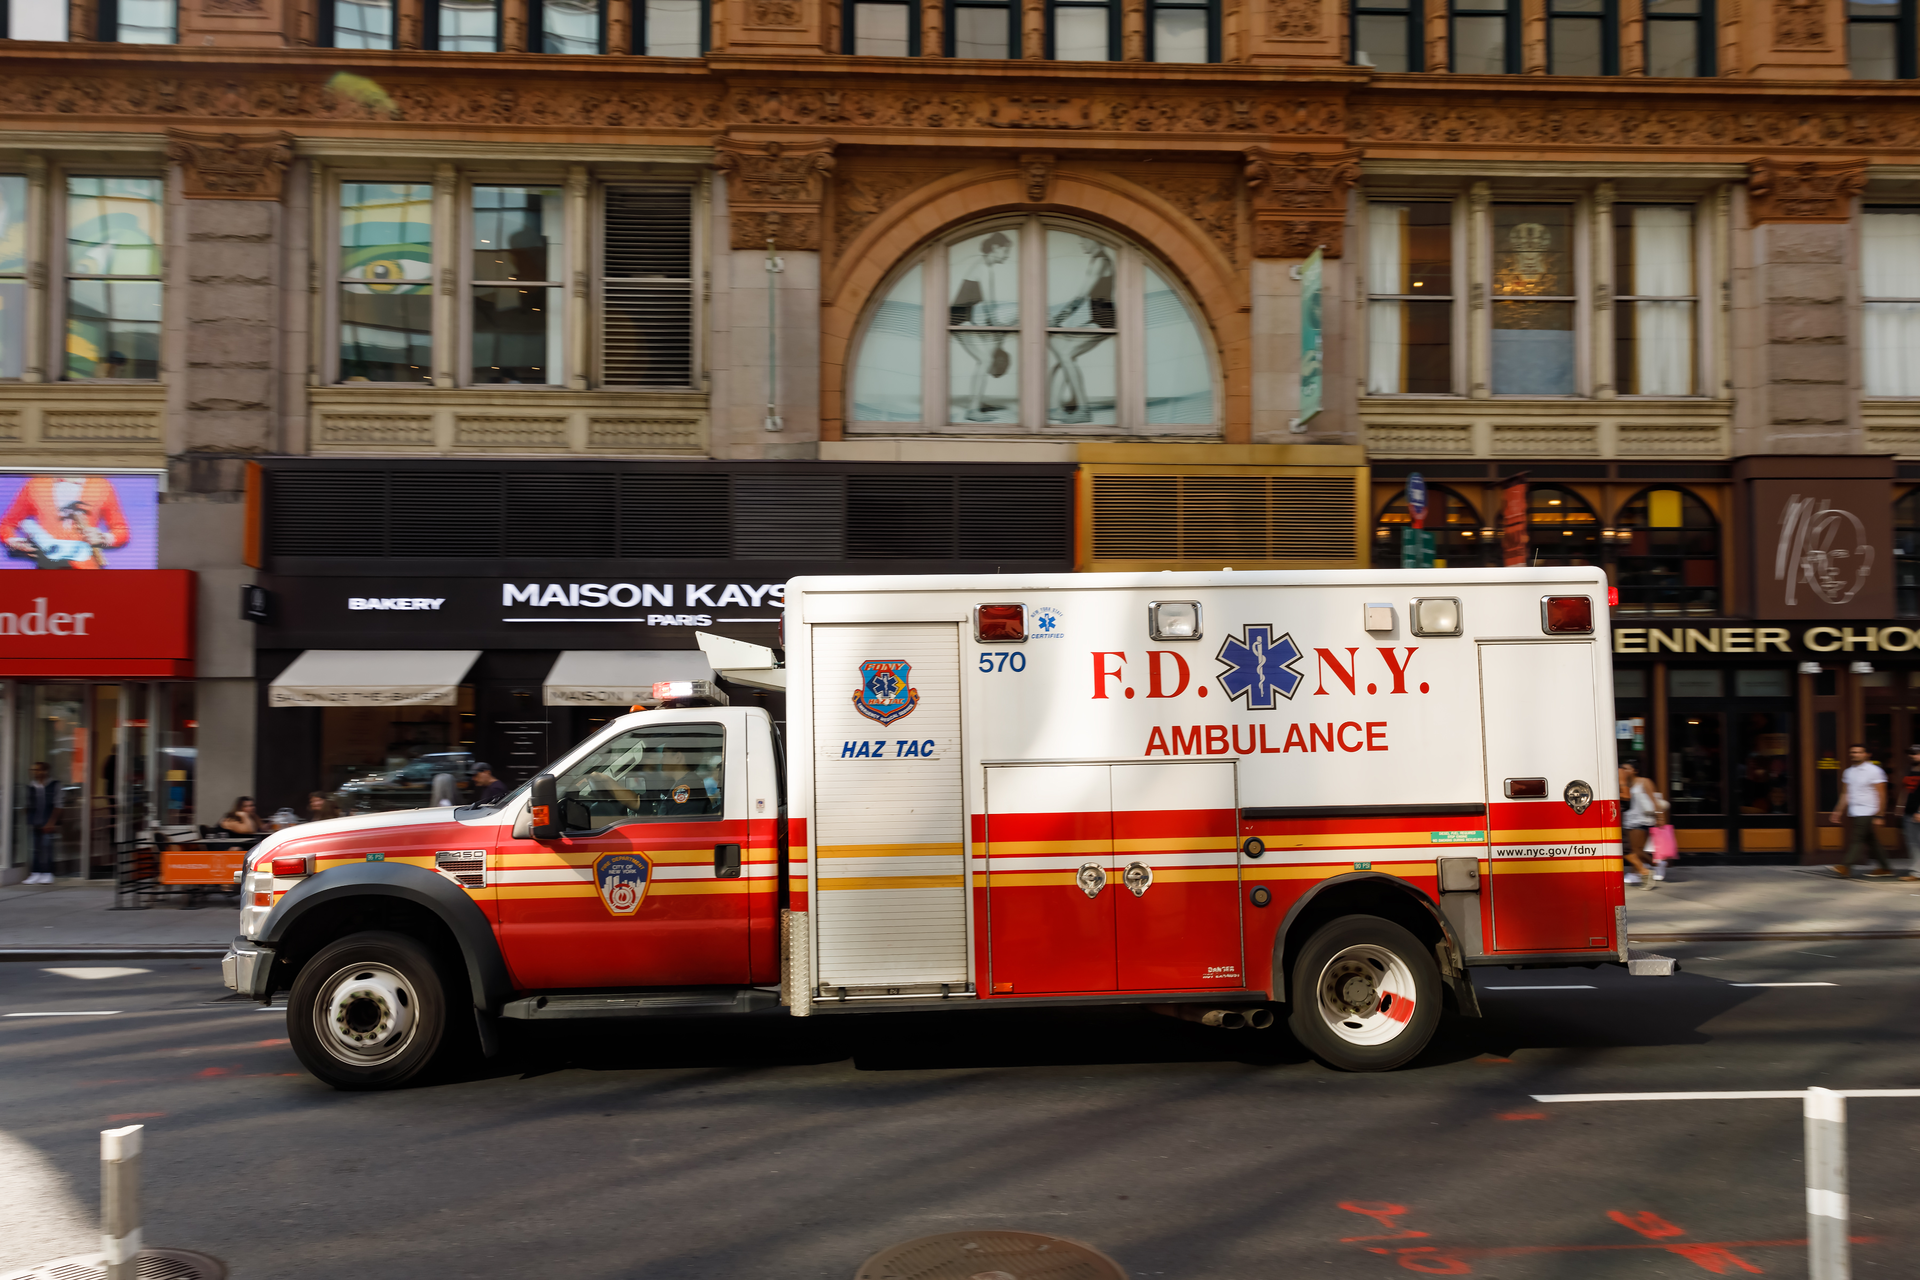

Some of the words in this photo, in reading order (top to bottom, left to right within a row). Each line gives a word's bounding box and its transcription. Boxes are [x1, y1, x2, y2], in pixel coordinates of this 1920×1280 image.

[348, 597, 446, 610] BAKERY
[503, 583, 674, 607] MAISON
[0, 597, 95, 636] nder
[647, 614, 713, 627] PARIS
[1613, 627, 1793, 653] ENNER
[864, 663, 905, 671] FDNY
[978, 651, 1026, 673] 570
[841, 740, 887, 758] HAZ
[896, 739, 935, 758] TAC
[1144, 721, 1389, 756] AMBULANCE
[1497, 845, 1597, 858] www.nyc.gov/fdny
